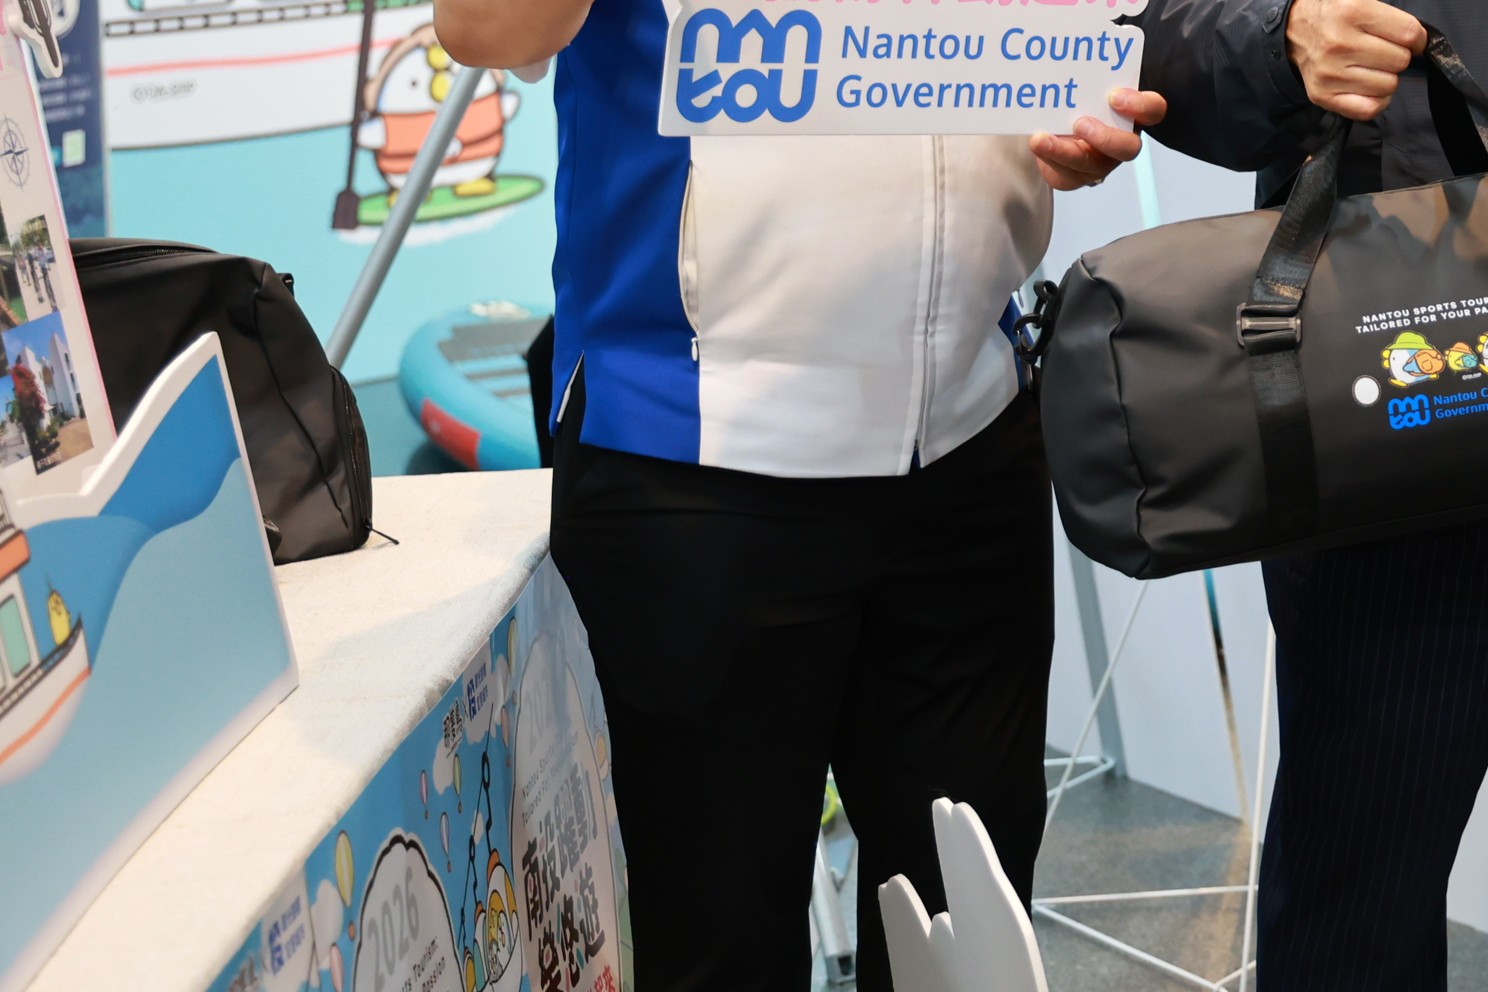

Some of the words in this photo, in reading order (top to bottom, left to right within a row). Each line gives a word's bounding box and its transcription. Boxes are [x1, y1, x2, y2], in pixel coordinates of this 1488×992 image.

[841, 25, 984, 61] Nantou
[1001, 27, 1134, 72] County
[836, 75, 1078, 110] Government
[1355, 318, 1411, 334] TAILORED
[1414, 314, 1438, 325] FOR
[1440, 308, 1471, 320] YOUR
[1362, 308, 1410, 324] NANTOU
[1413, 301, 1457, 316] SPORTS
[1433, 389, 1478, 406] Nantou
